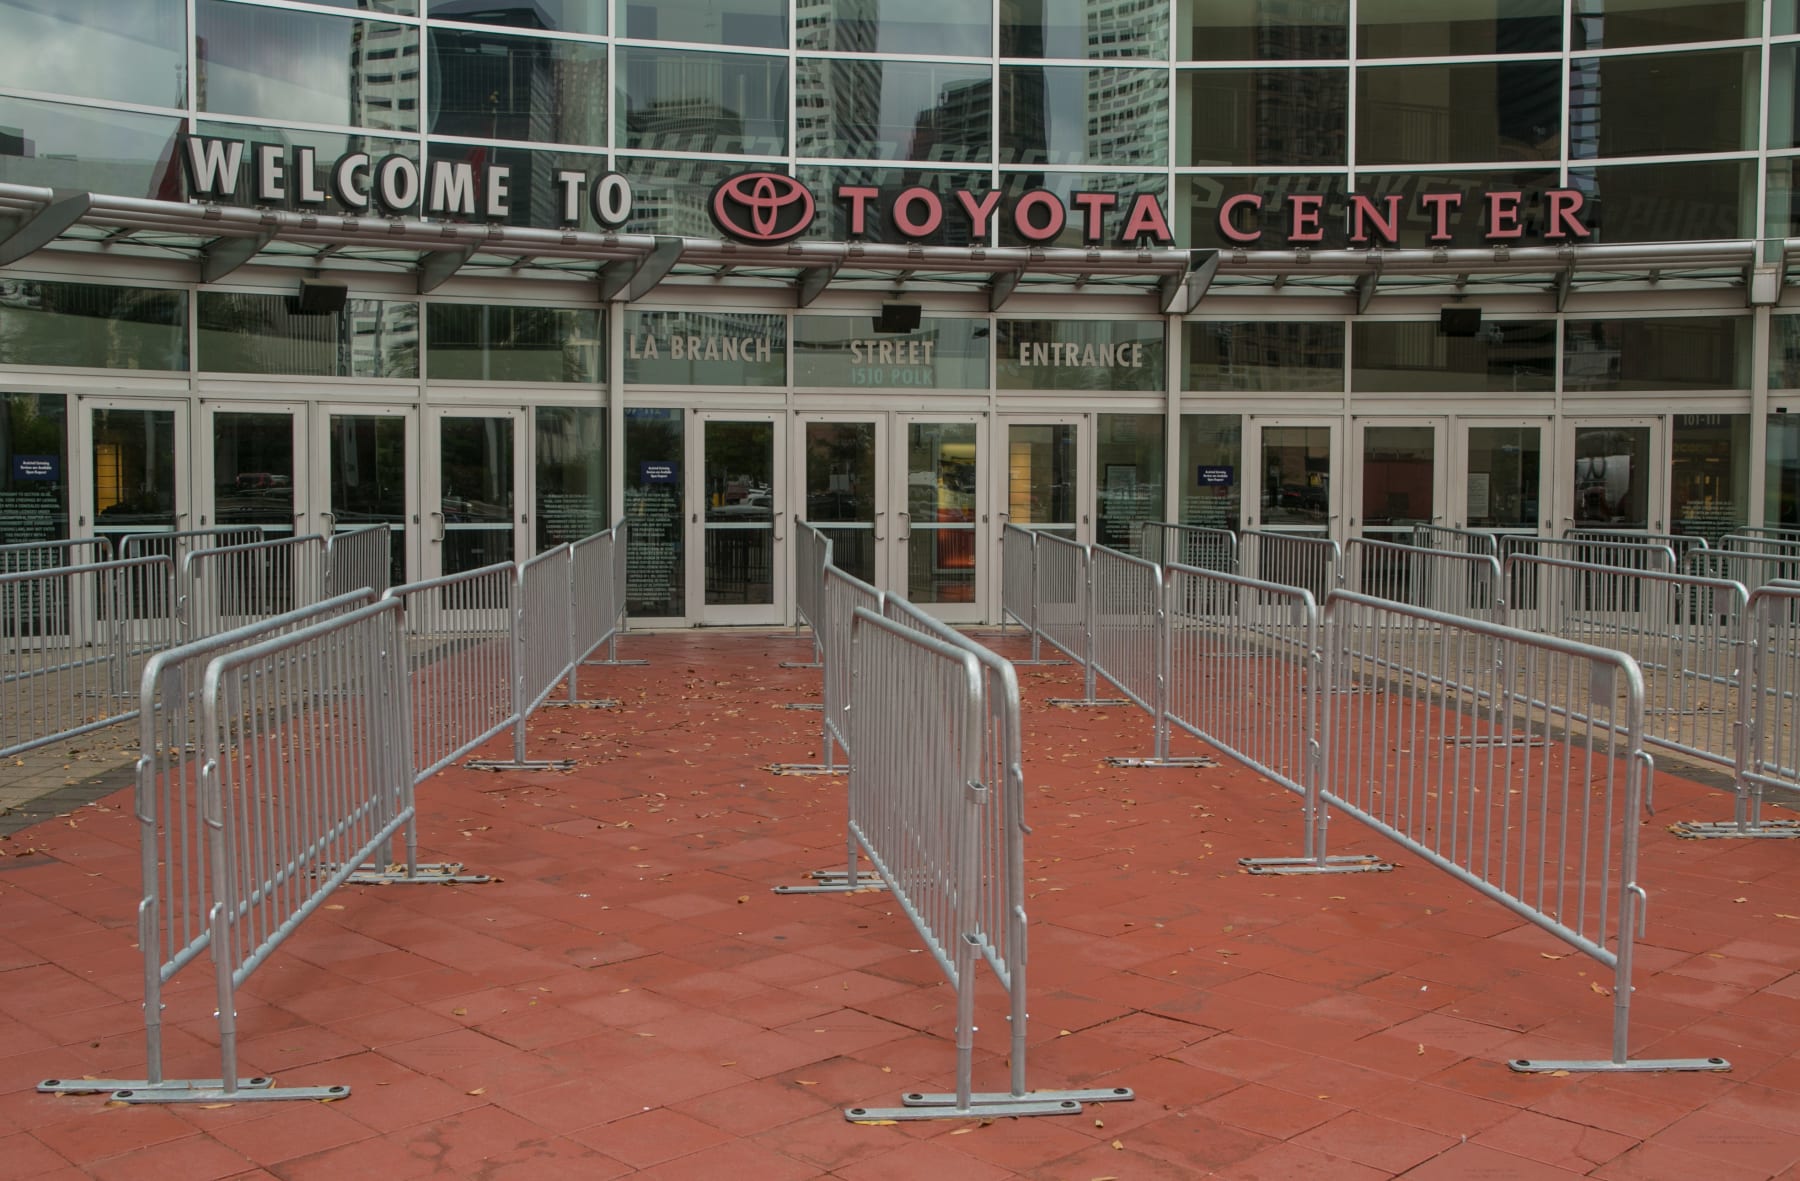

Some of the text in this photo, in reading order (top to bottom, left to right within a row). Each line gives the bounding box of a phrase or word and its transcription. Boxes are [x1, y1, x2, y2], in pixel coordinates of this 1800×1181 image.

[186, 136, 511, 218] WELCOME
[558, 170, 632, 223] TO
[838, 186, 1171, 241] TOYOTA
[1218, 190, 1591, 242] CENTER
[629, 334, 1143, 368] LA BRANCH STREET ENTRANCE
[851, 367, 933, 385] 1510 POLK
